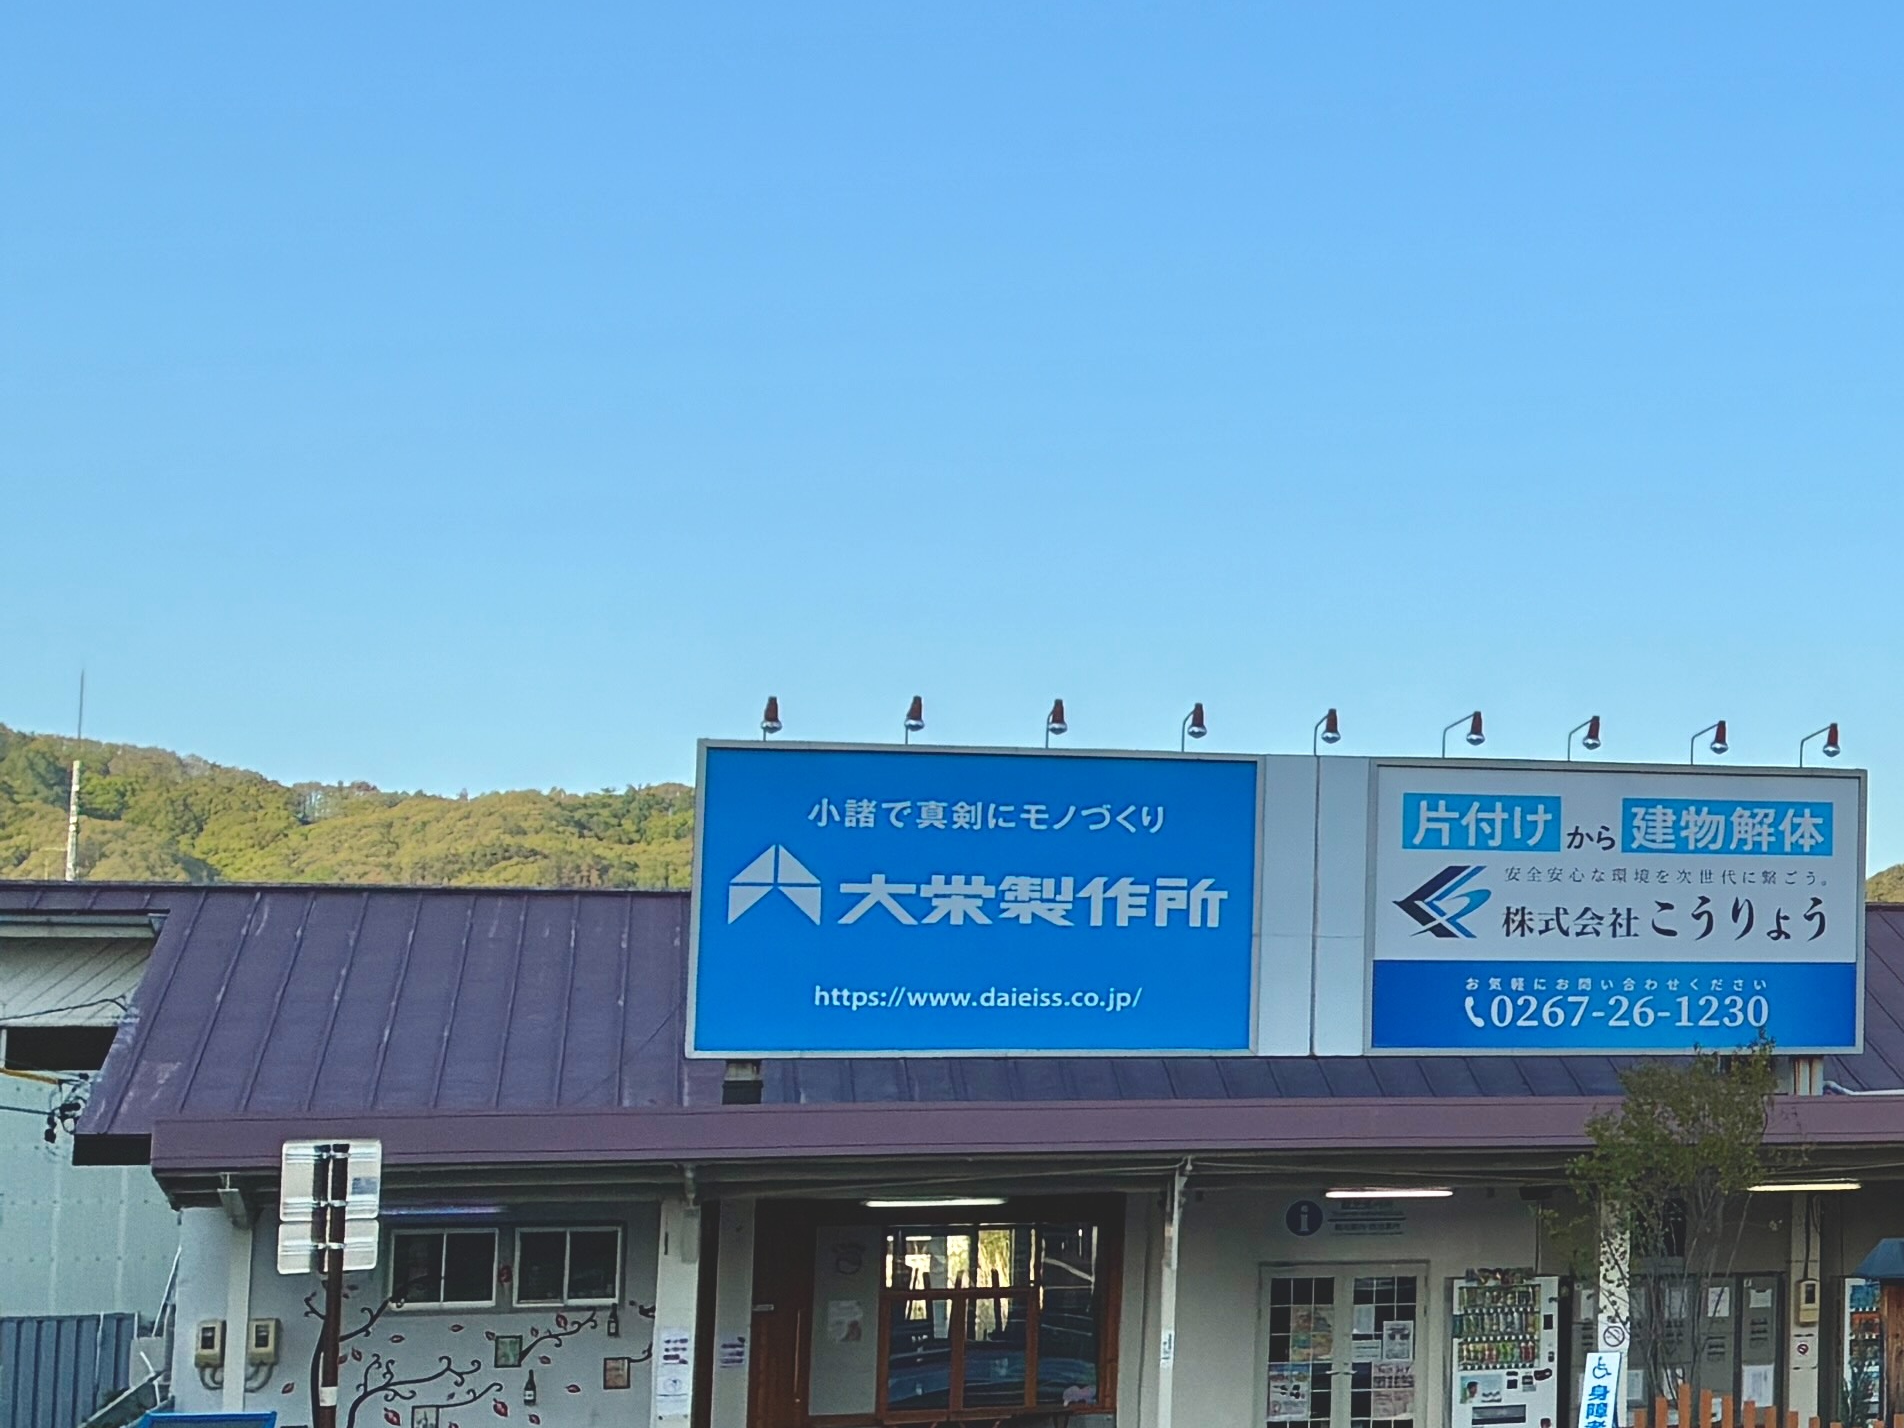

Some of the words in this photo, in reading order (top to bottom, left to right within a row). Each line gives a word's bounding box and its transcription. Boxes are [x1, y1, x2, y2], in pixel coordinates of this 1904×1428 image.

[807, 798, 1167, 834] 小諸で真剣にモノづくり
[837, 873, 1229, 928] 大栄製作所
[1502, 895, 1828, 942] 株式会社こうりょう
[814, 985, 1143, 1011] https://www.daieiss.co.jp/
[1465, 976, 1768, 992] お気軽にお問い合わせください
[1490, 994, 1770, 1029] 0267-26-1230
